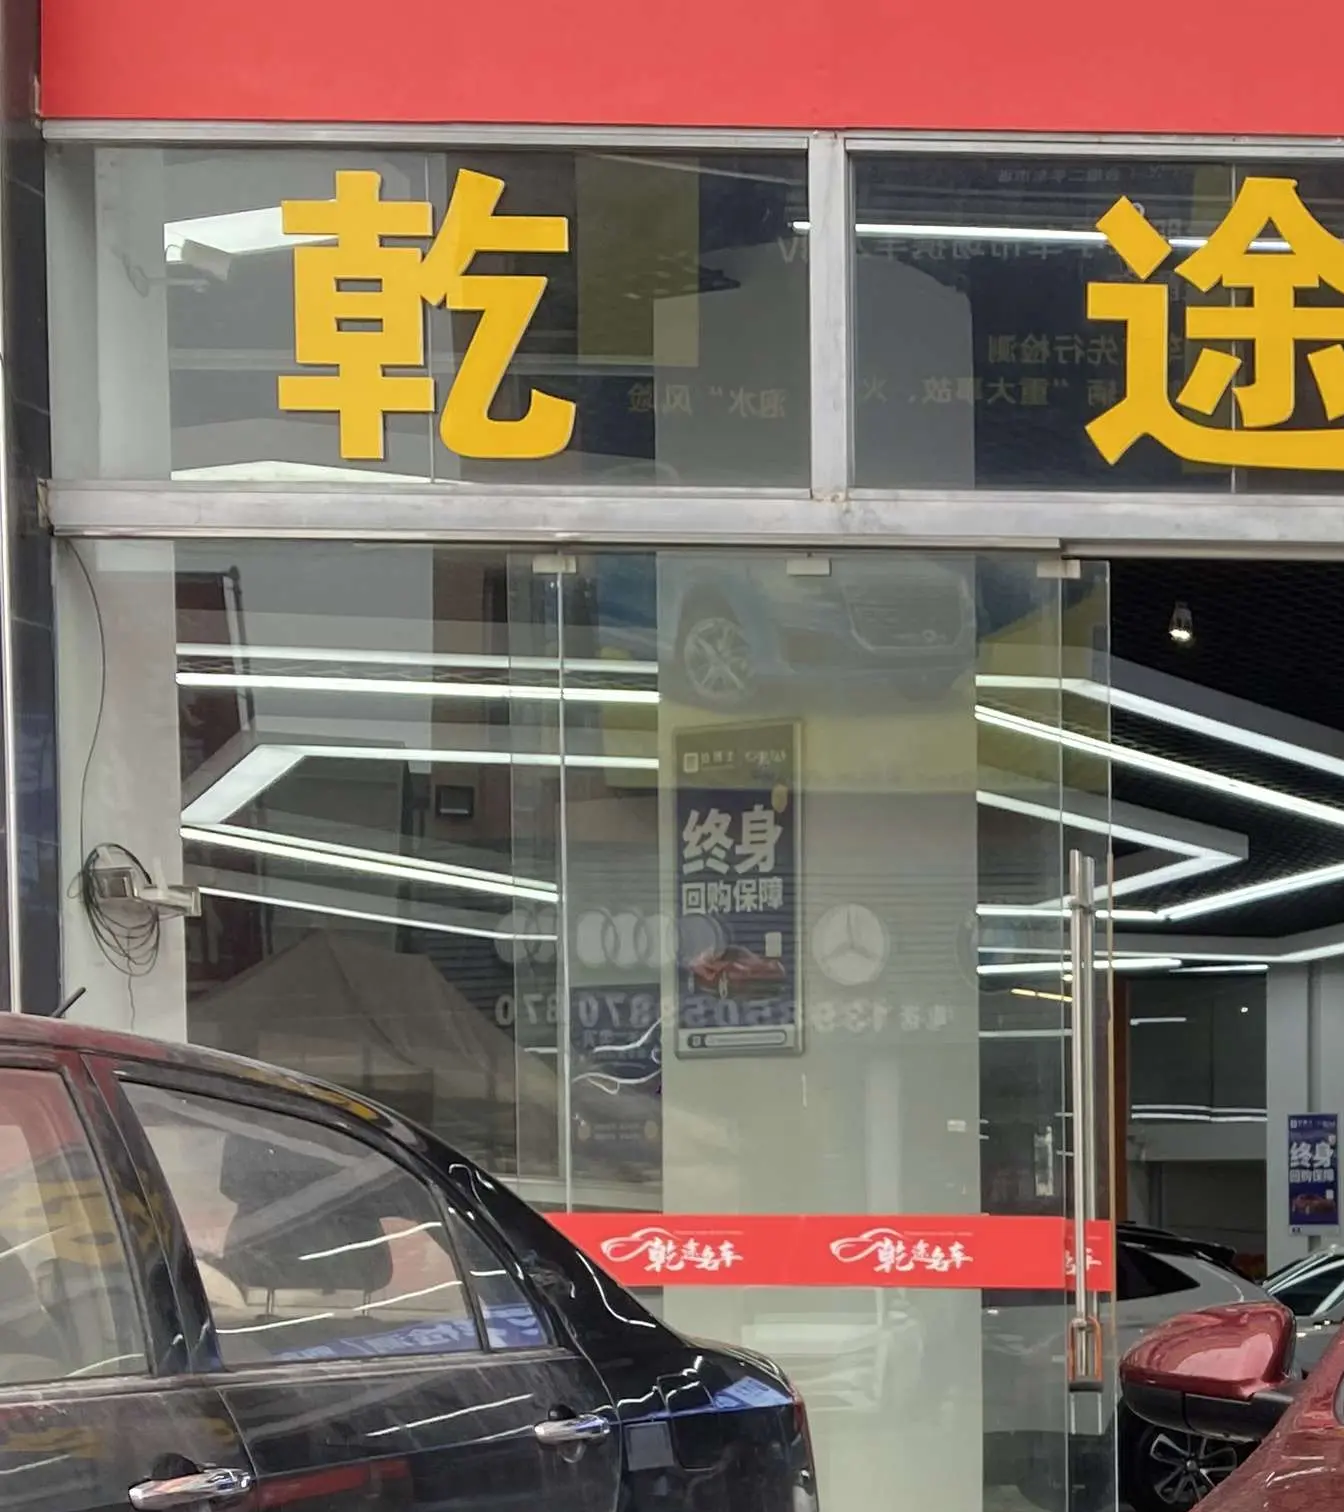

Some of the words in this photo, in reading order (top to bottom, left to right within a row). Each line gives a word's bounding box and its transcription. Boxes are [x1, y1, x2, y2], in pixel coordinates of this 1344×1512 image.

[682, 804, 782, 875] 终身
[682, 877, 783, 915] 回购保障
[1290, 1141, 1334, 1168] 终身
